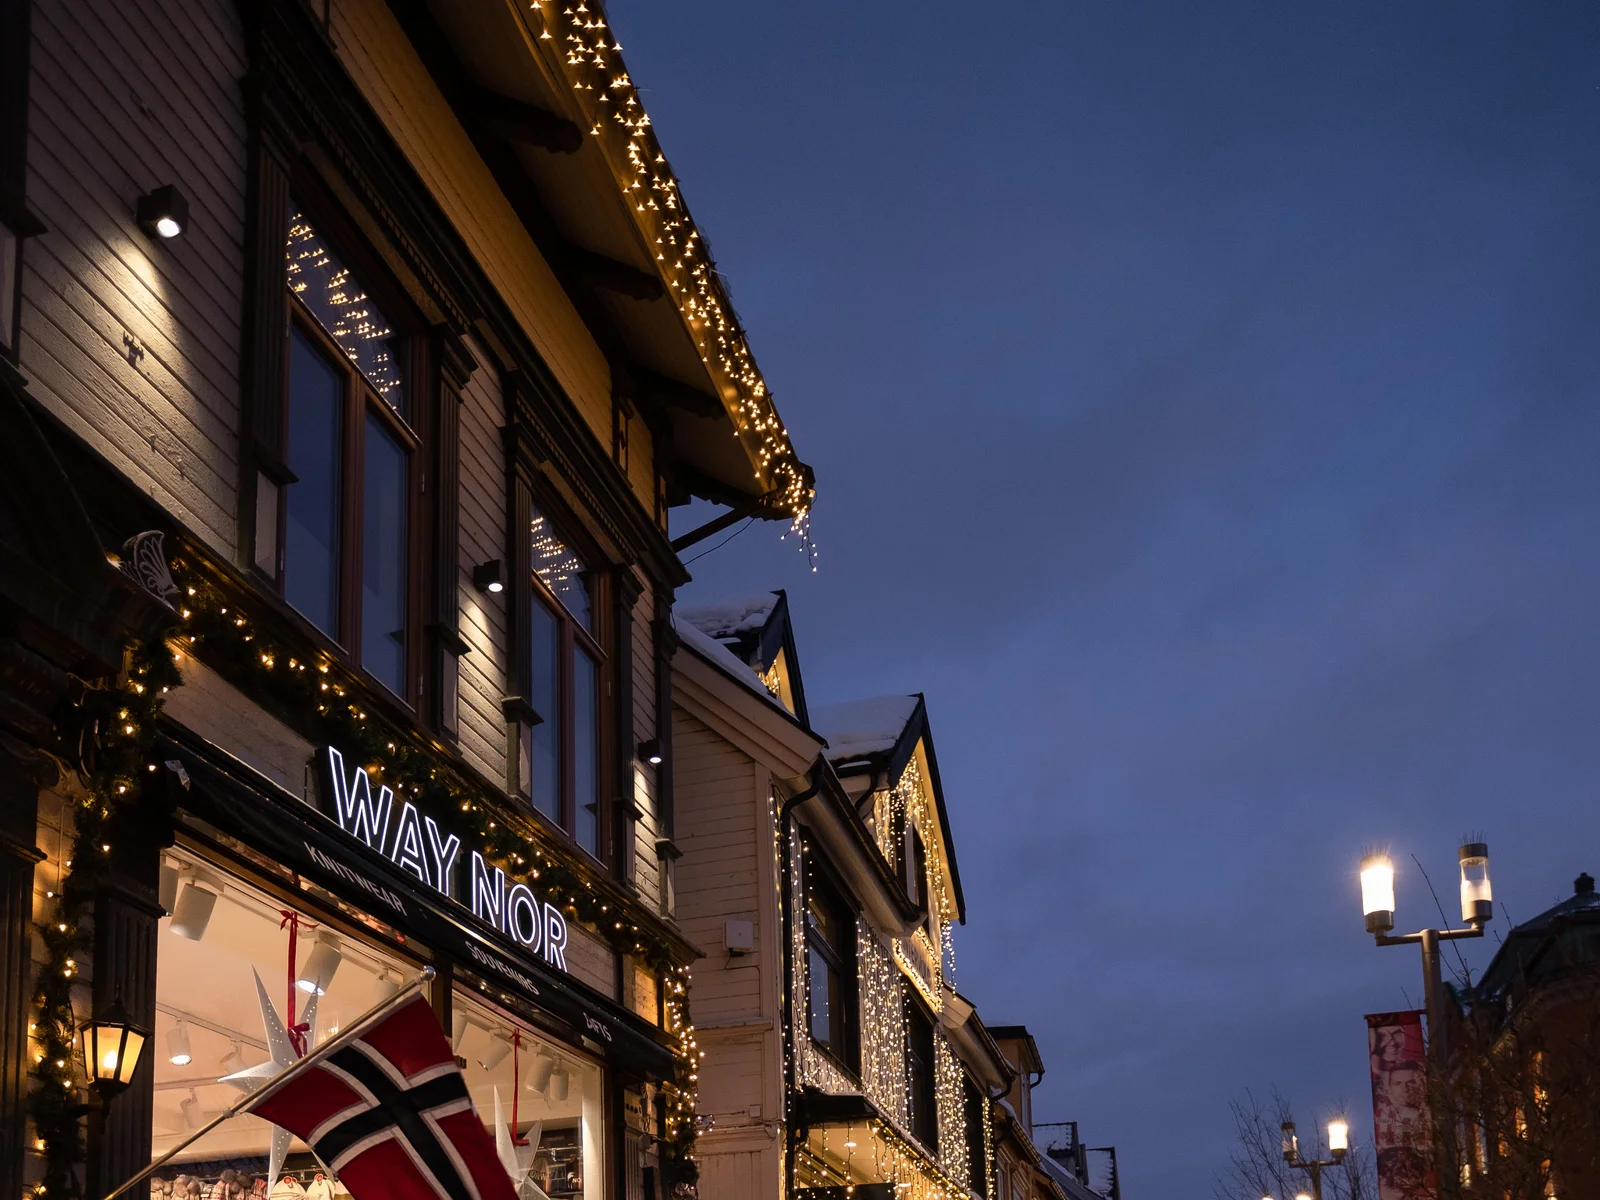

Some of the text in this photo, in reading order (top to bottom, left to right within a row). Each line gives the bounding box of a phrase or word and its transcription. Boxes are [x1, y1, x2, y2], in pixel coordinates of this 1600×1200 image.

[303, 841, 408, 917] KNITWEAR
[328, 745, 569, 973] WAY NOR
